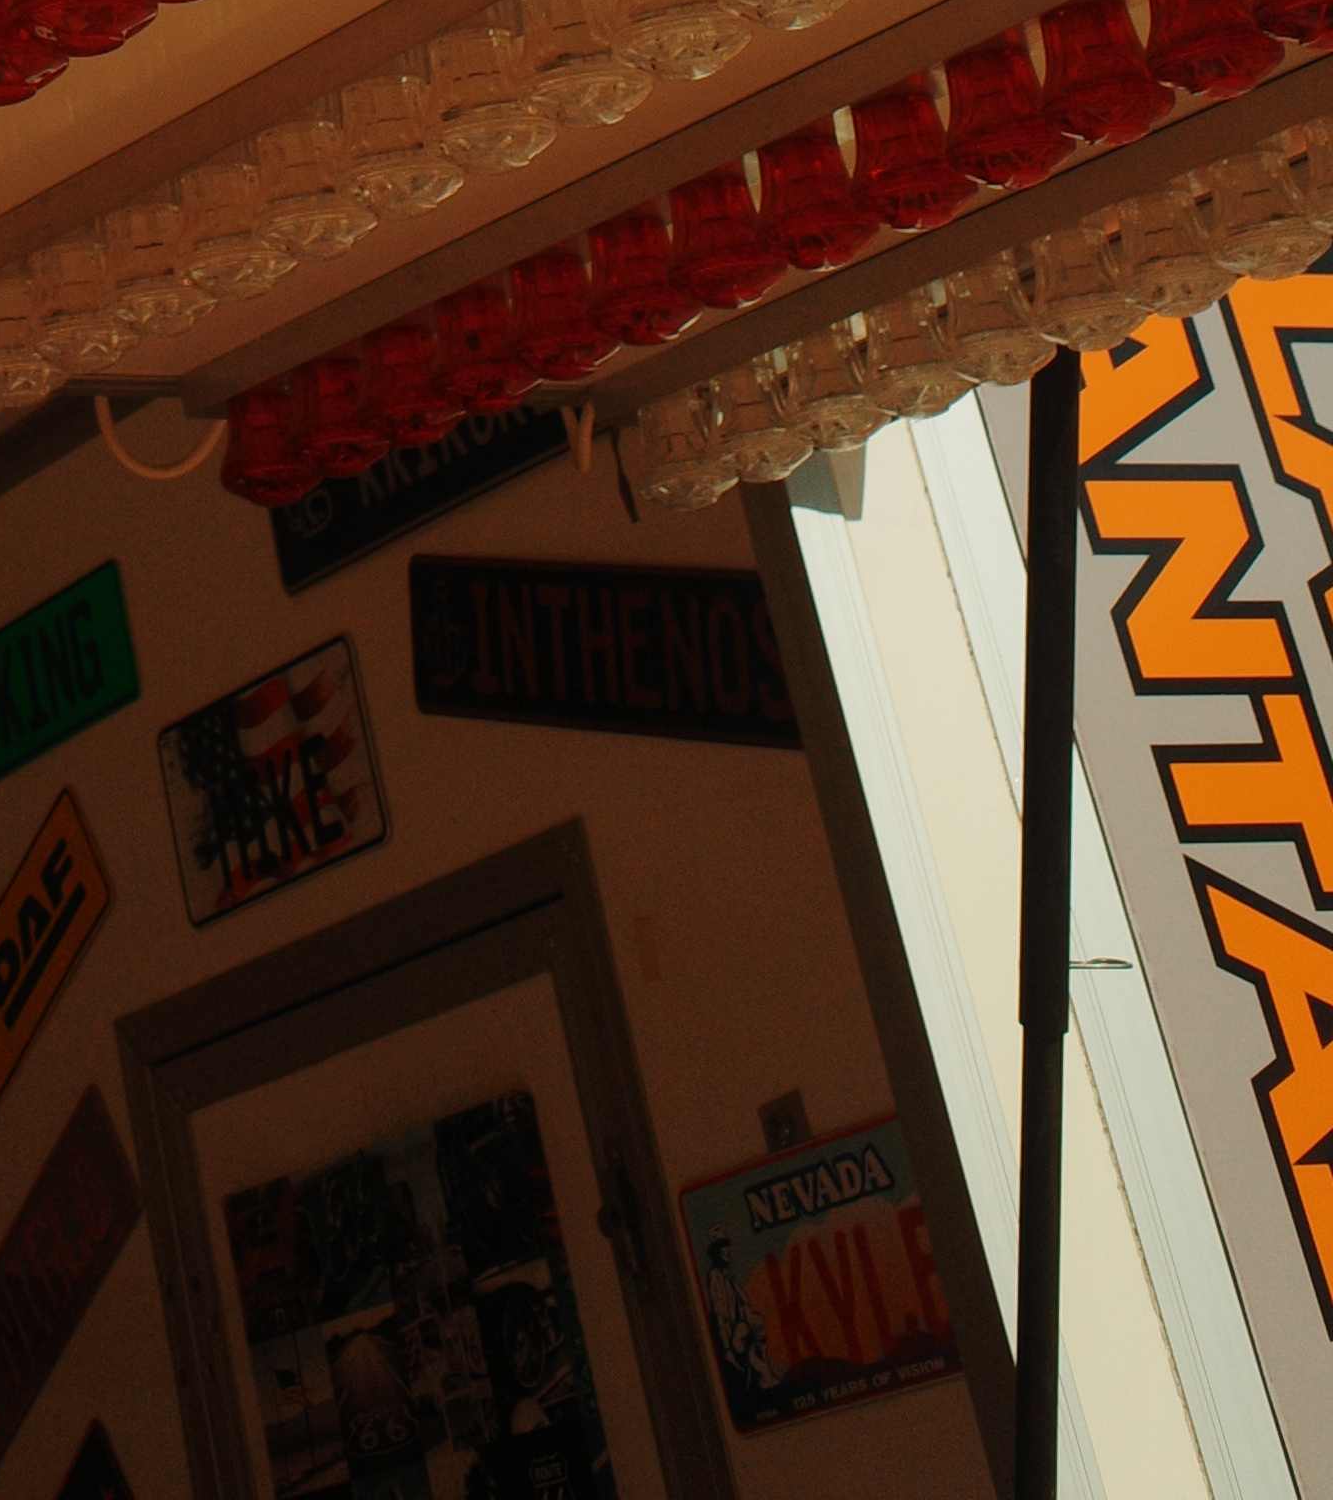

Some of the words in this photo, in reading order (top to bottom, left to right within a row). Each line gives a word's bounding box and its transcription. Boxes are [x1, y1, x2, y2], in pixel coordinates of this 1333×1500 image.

[744, 1145, 895, 1232] NEVADA
[793, 1391, 818, 1411] 125
[821, 1377, 869, 1403] YEARS
[871, 1370, 893, 1389] OF
[897, 1359, 945, 1381] VISION
